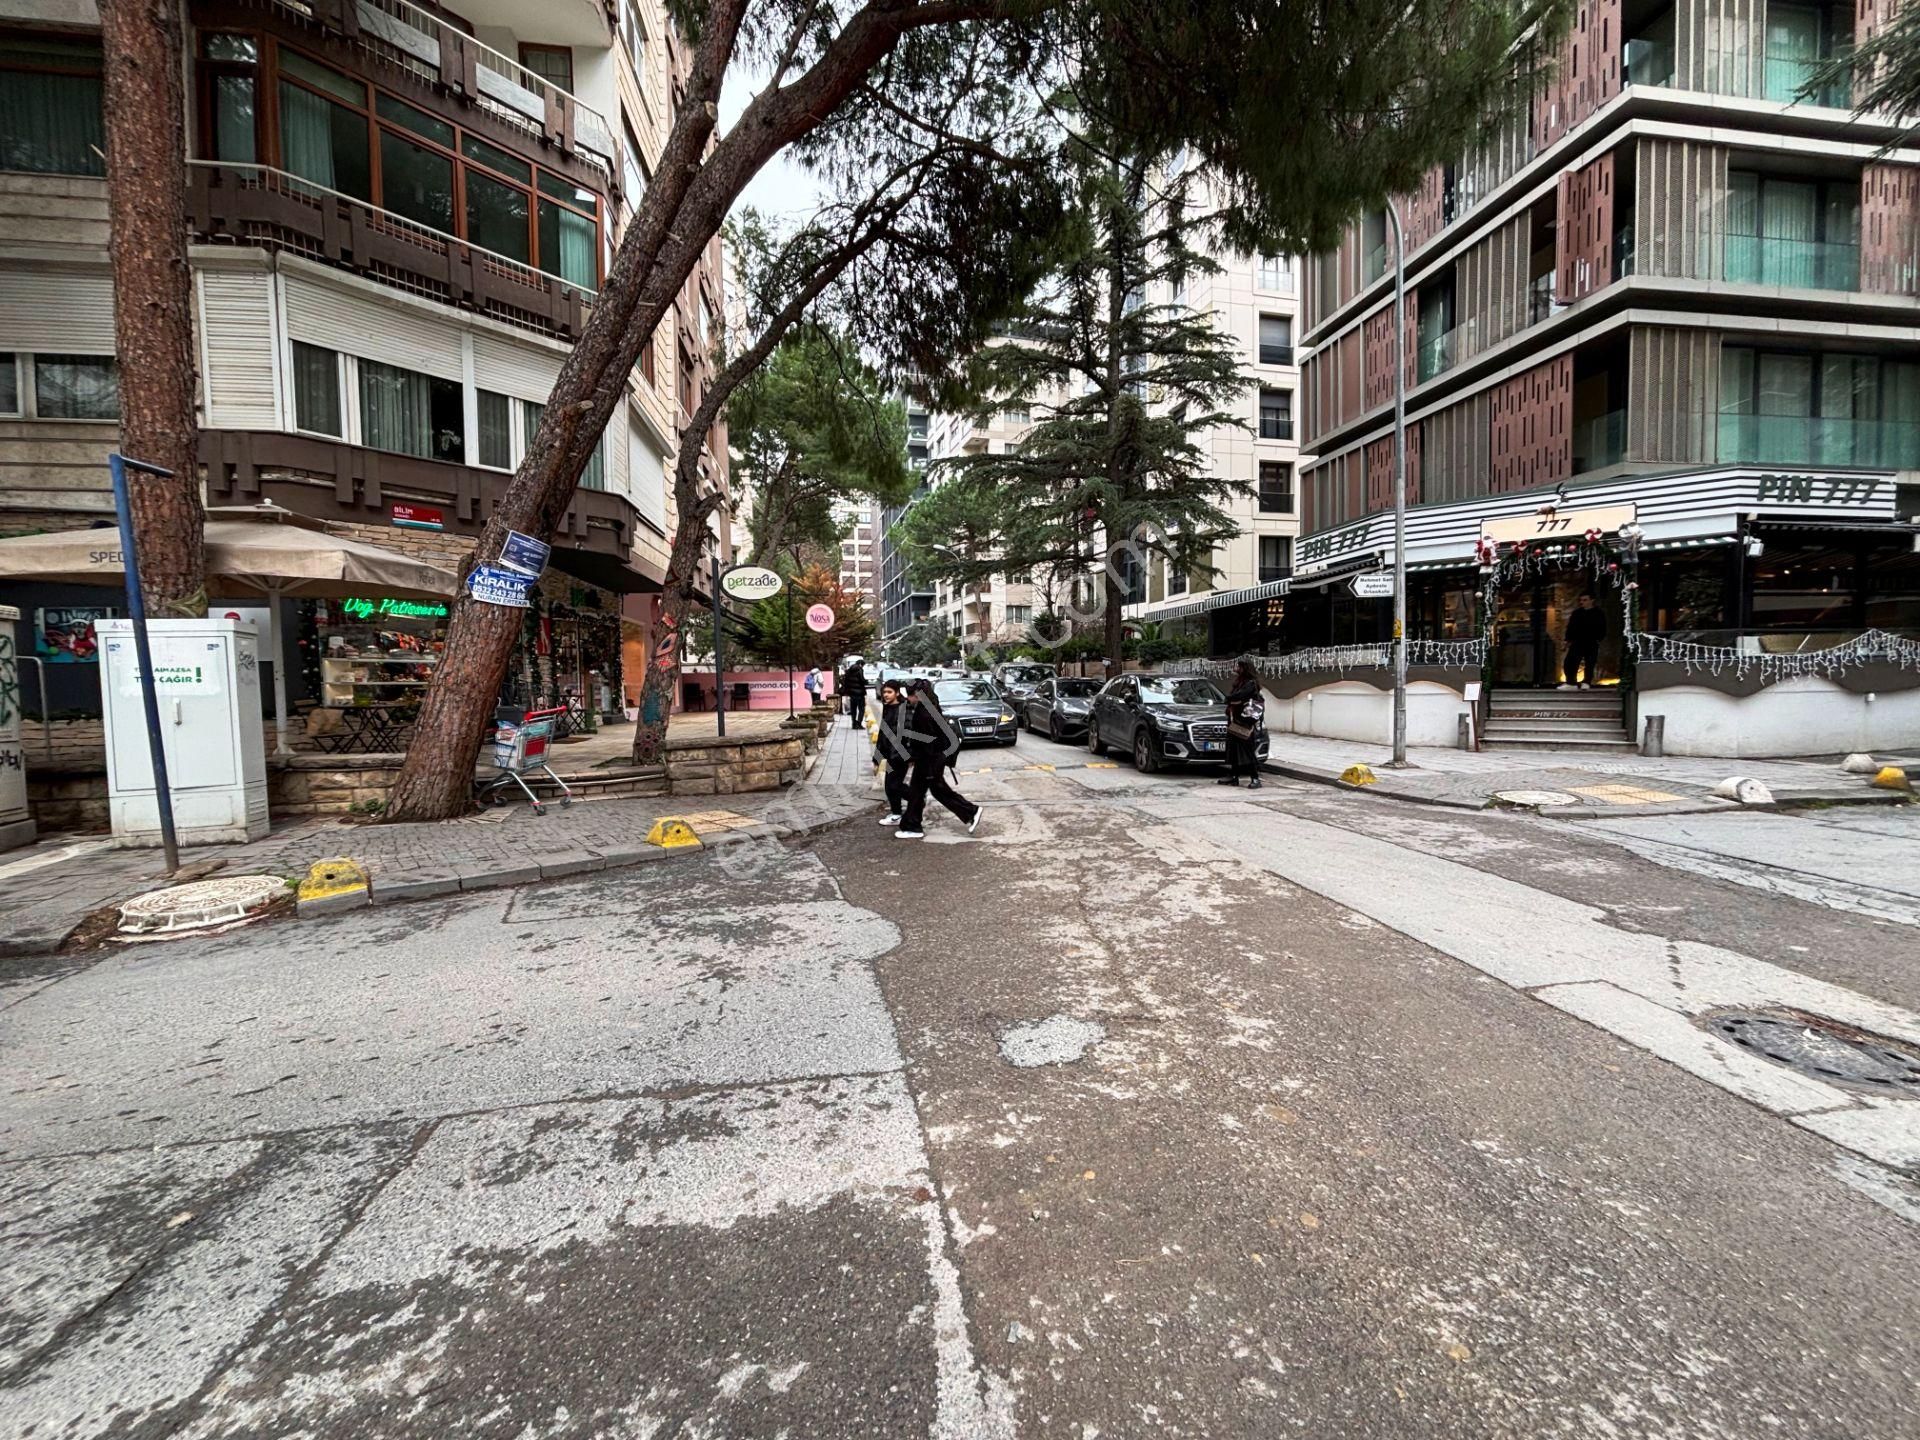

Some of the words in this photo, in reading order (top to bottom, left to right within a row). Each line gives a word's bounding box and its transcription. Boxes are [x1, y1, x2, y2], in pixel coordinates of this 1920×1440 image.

[1757, 474, 1814, 503] PIN
[1823, 477, 1880, 504] 777
[1536, 518, 1573, 533] 777
[1303, 535, 1333, 562] PIN
[1337, 523, 1372, 552] 777
[728, 574, 777, 590] petzade
[492, 588, 506, 597] 243
[380, 598, 448, 616] Patisserie
